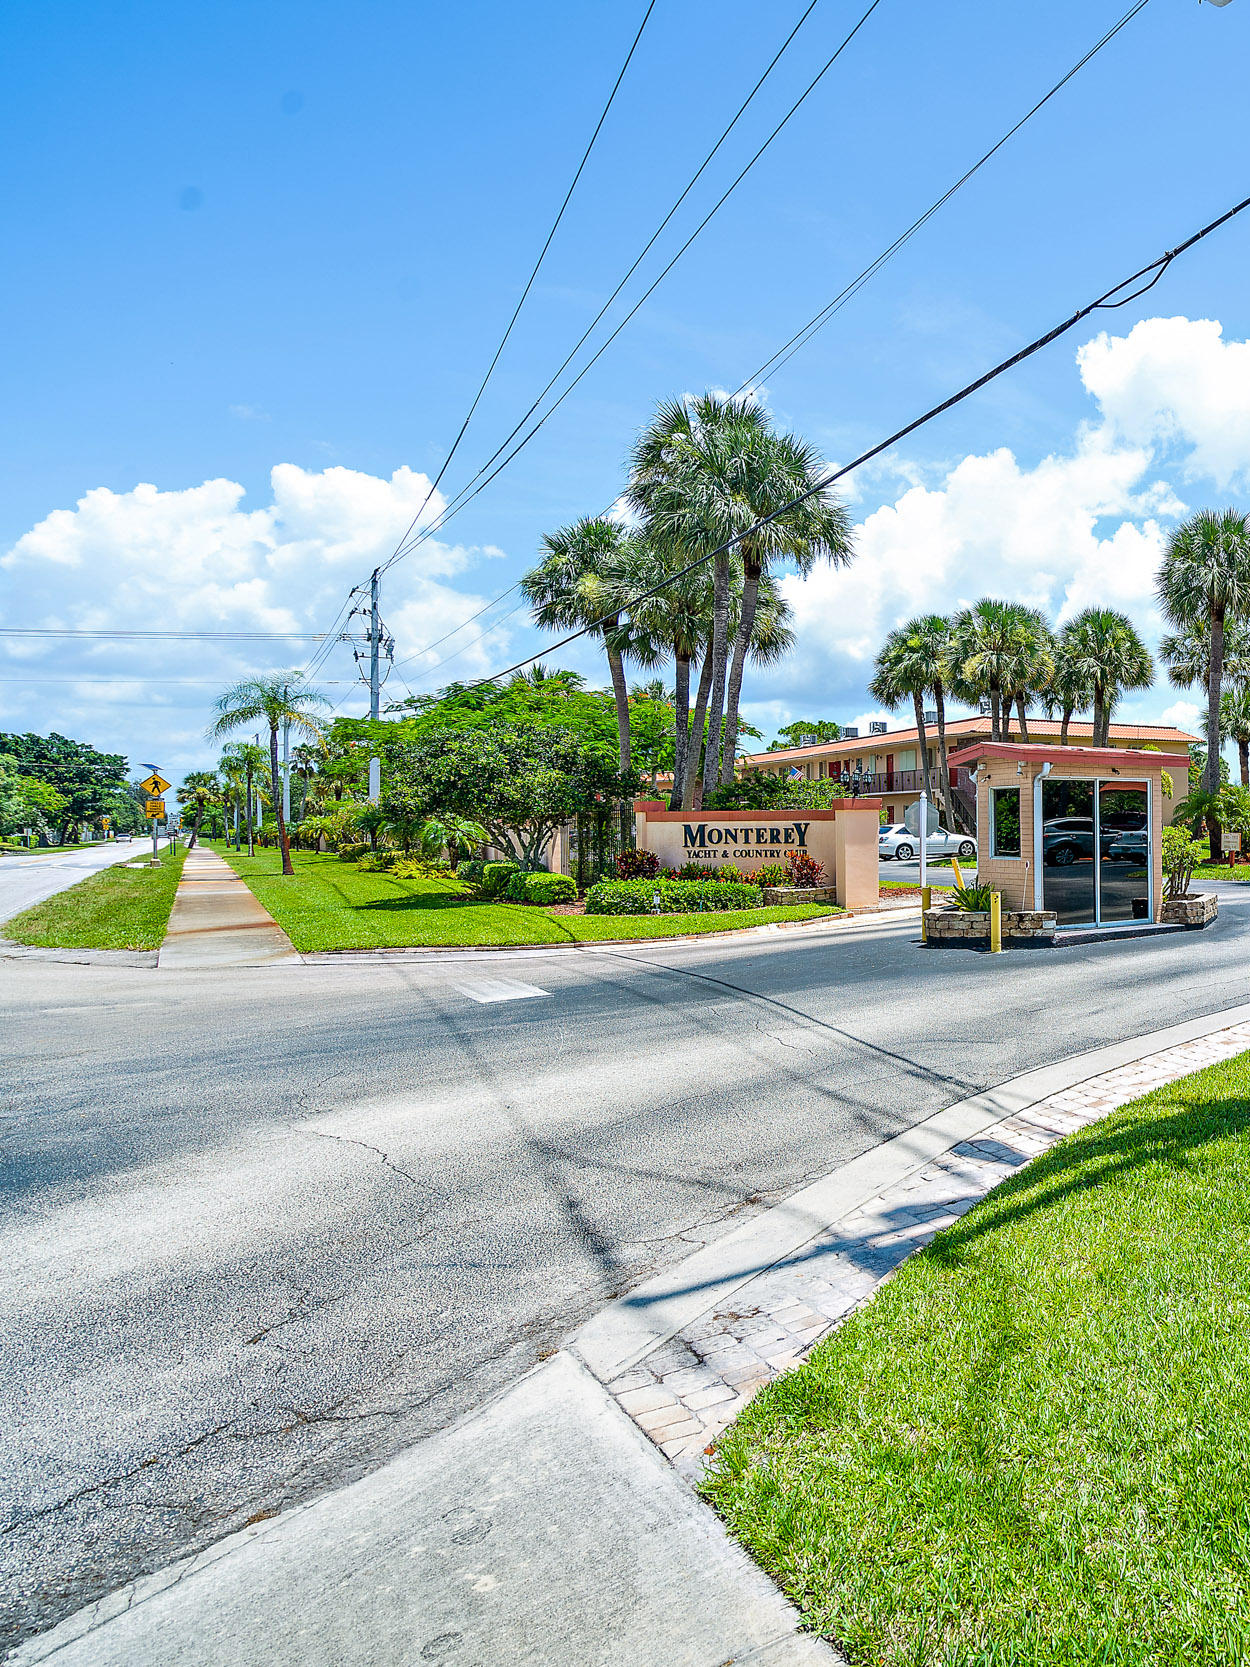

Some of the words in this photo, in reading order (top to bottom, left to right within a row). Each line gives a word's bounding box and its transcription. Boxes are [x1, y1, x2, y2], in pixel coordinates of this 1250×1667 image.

[681, 823, 810, 848] MONTEREY
[686, 849, 719, 859] YACHT
[721, 849, 730, 859] &
[733, 849, 782, 858] COUNTRY
